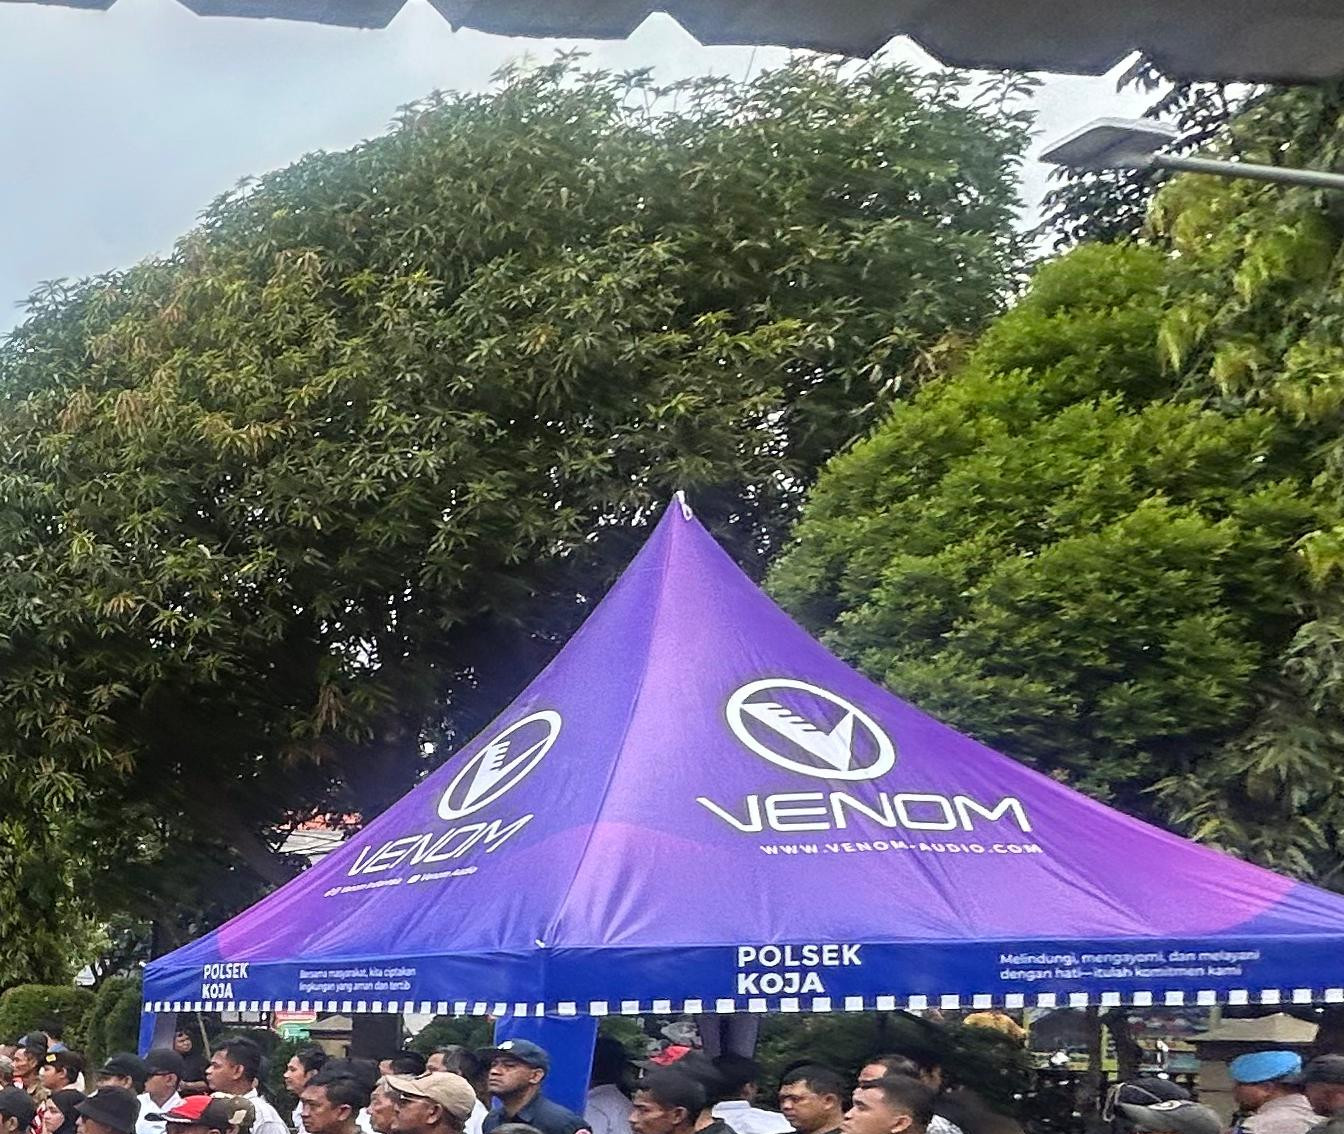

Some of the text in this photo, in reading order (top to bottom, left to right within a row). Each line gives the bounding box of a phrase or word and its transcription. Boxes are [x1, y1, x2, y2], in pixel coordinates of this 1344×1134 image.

[695, 791, 1034, 832] VENOM
[347, 813, 535, 877] VENOM
[759, 840, 1044, 856] WWW.VENOM-AUDIO.COM
[737, 944, 862, 968] POLSEK
[1168, 950, 1196, 962] dan
[203, 963, 250, 979] POLSEK
[999, 969, 1053, 981] dengan
[201, 983, 234, 999] KOJA
[737, 971, 825, 995] KOJA
